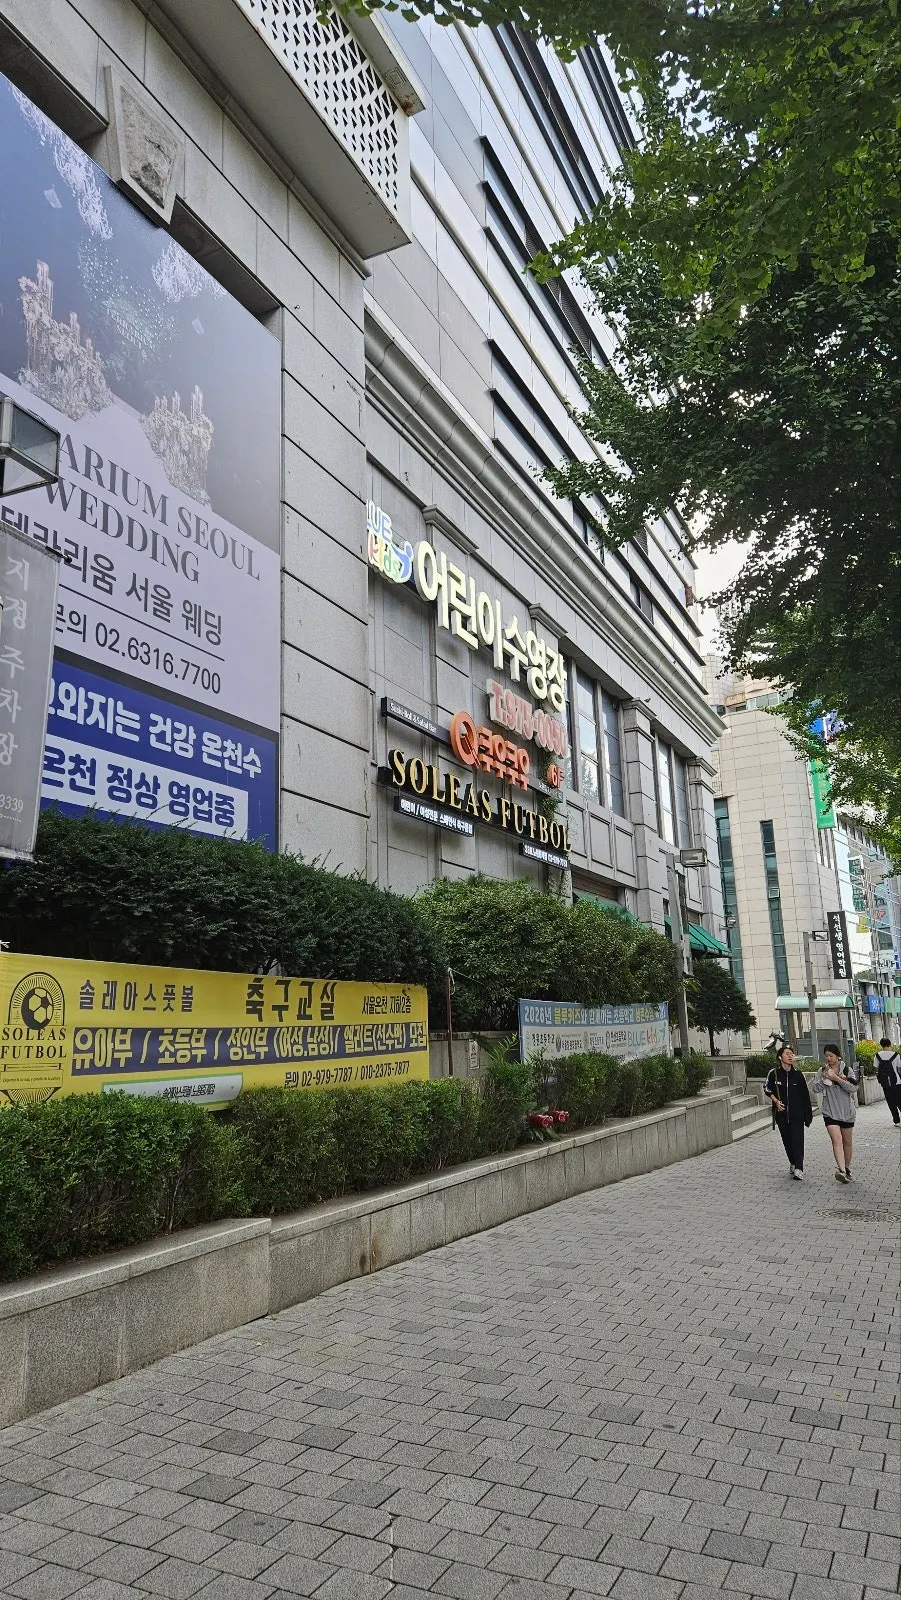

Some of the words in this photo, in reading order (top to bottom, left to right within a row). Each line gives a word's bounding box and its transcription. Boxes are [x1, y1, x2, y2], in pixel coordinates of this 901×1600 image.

[46, 476, 200, 583] WEDDING
[177, 506, 260, 581] SEOUL
[126, 571, 173, 623] 서울
[181, 599, 222, 646] 웨딩
[415, 540, 568, 712] 어린이수영장
[95, 621, 222, 694] 02.6316.7700
[149, 713, 197, 759] 건강
[201, 731, 262, 779] 온천수
[107, 763, 160, 810] 정상
[168, 780, 235, 828] 영업중
[389, 748, 491, 822] SOLEAS
[498, 797, 571, 852] FUTBOL
[79, 979, 194, 1013] 솔레아스풋볼
[245, 976, 338, 1023] 축구교실
[361, 995, 388, 1016] 서울온천
[524, 1005, 552, 1025] 2026년
[0, 1045, 68, 1059] FUTBOL
[2, 1026, 67, 1041] SOLEAS
[72, 1027, 133, 1070] 유아부
[140, 1030, 152, 1064] /
[157, 1028, 208, 1064] 초등부
[214, 1029, 223, 1060] /
[226, 1026, 269, 1061] 성인부
[409, 1021, 427, 1048] 모집
[284, 1070, 299, 1089] 문의
[301, 1066, 353, 1087] 02-979-7787
[360, 1060, 410, 1081] 010-2375-7877
